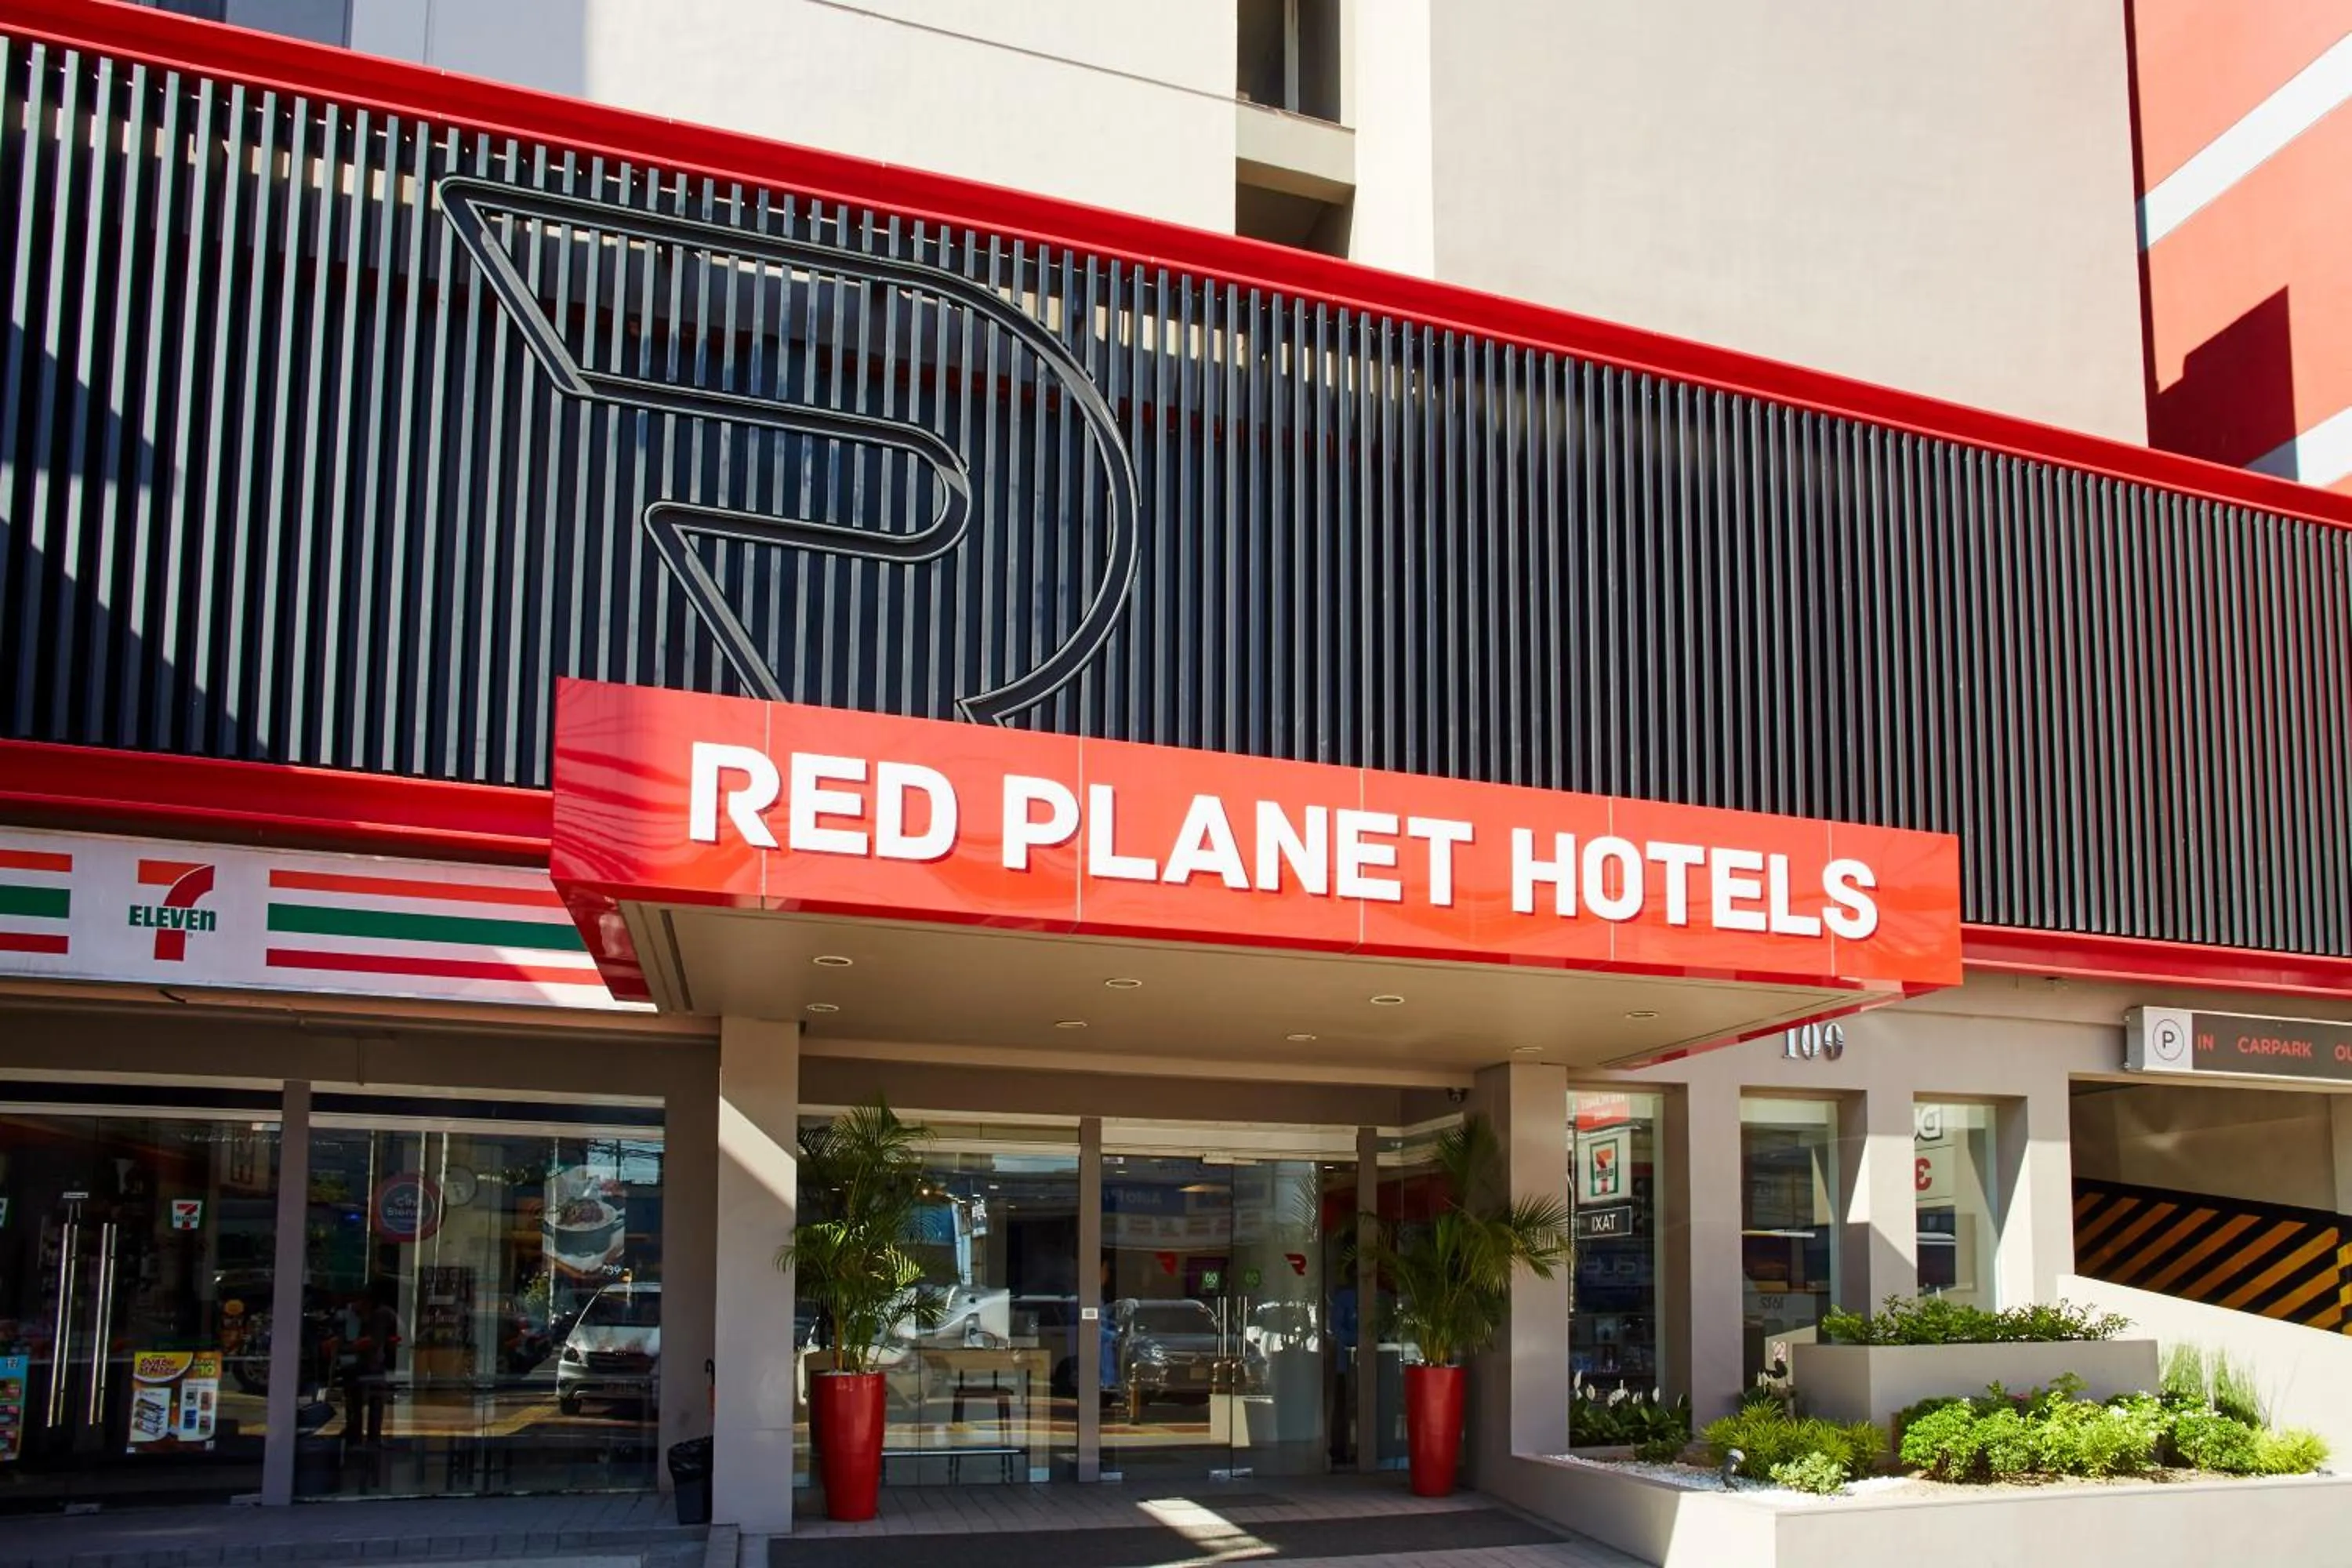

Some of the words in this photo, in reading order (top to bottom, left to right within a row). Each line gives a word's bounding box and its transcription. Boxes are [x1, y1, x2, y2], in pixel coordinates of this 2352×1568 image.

[690, 742, 960, 862] RED
[1002, 774, 1475, 906] PLANET
[1512, 828, 1880, 941] HOTELS
[137, 859, 216, 961] 7
[2161, 1031, 2176, 1049] P
[2198, 1034, 2214, 1052] IN
[2238, 1036, 2312, 1058] CARPARK
